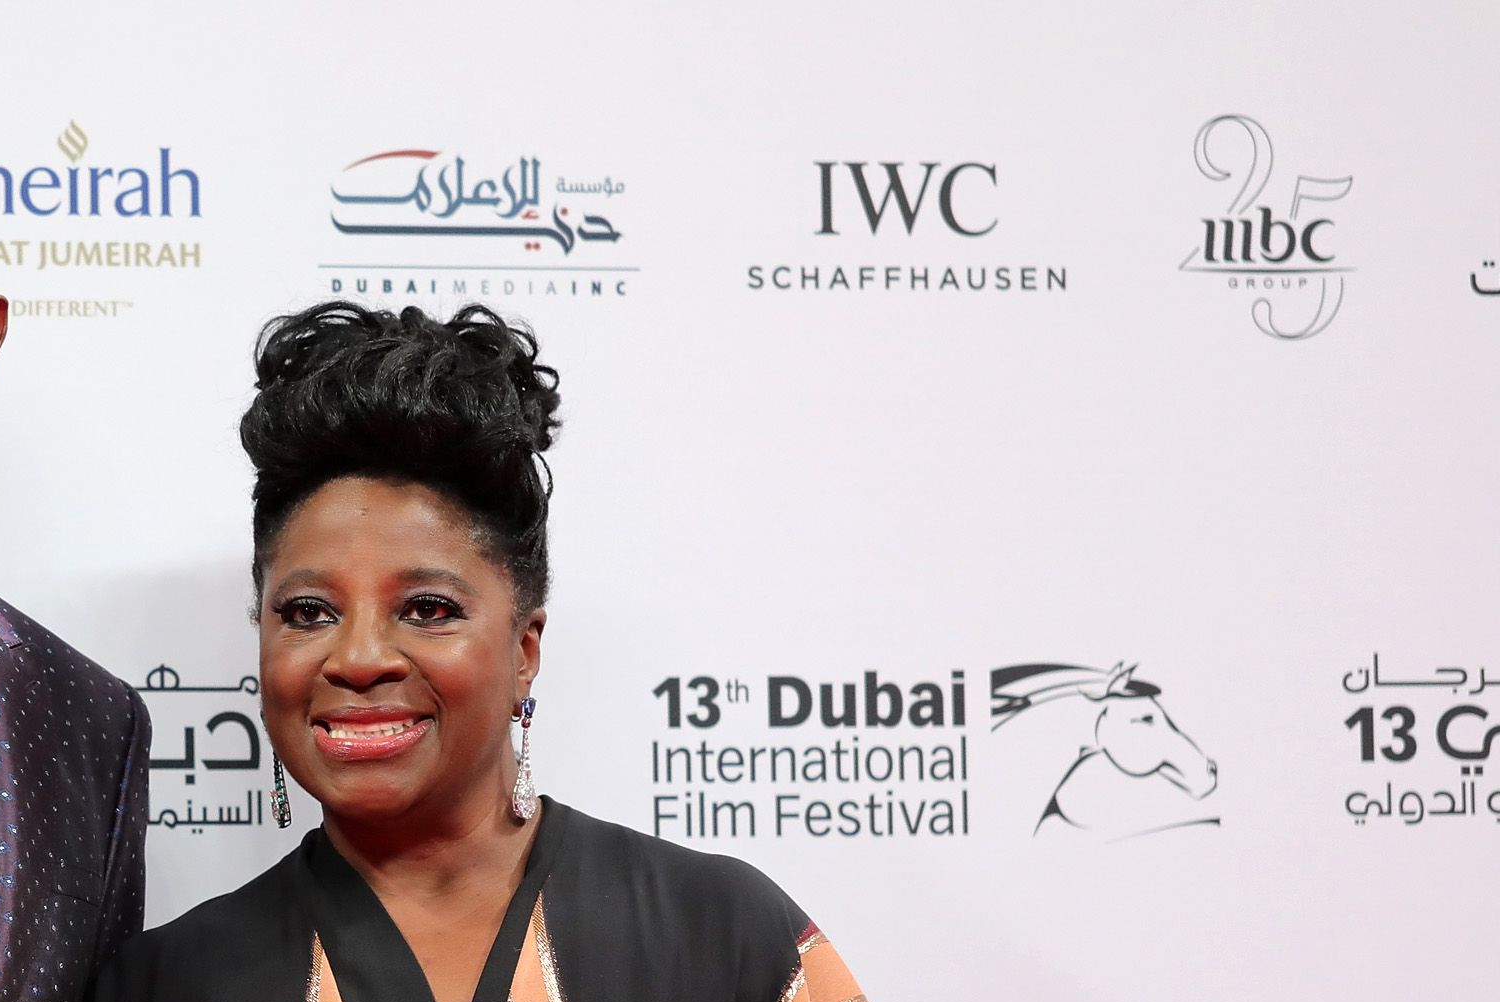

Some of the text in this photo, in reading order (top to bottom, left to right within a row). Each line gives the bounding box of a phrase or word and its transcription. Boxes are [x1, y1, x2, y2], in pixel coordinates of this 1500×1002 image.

[815, 162, 997, 237] IWC
[38, 241, 200, 270] JUMEIRAH
[748, 266, 1066, 290] SCHAFFHAUSEN
[1226, 278, 1308, 289] GROUP
[653, 670, 966, 729] 13th Dubai
[150, 711, 261, 785] دب
[1345, 706, 1417, 762] 13
[653, 736, 967, 783] International
[652, 790, 968, 837] Film Festival
[1345, 781, 1475, 825] الدولي
